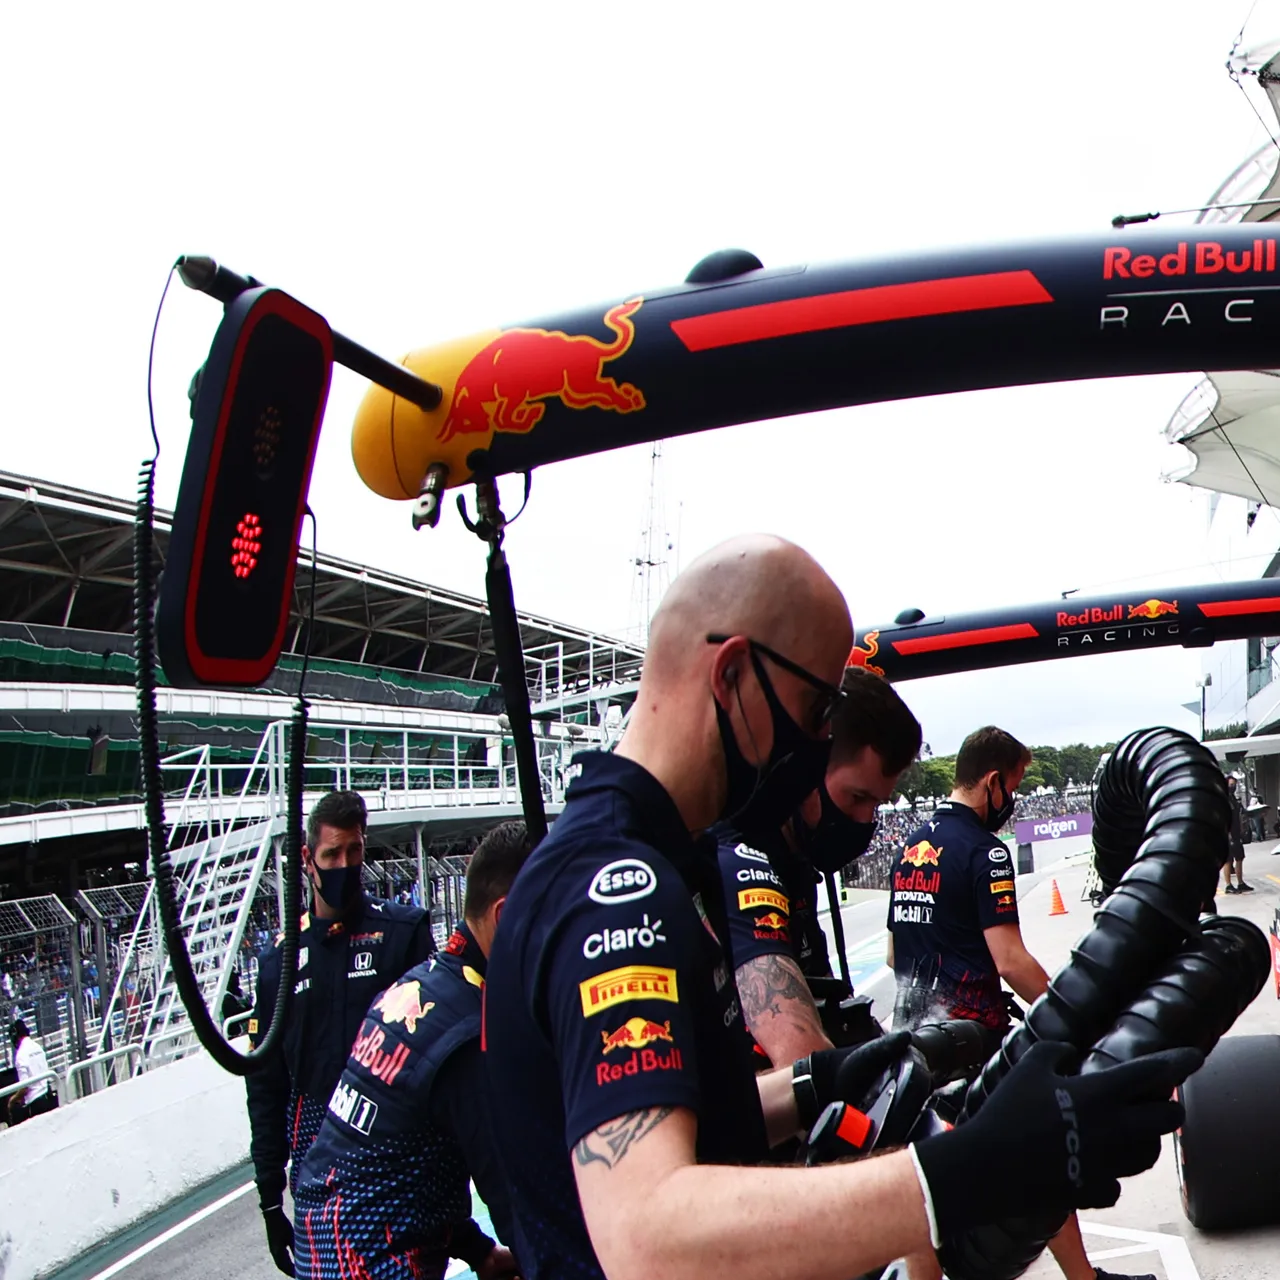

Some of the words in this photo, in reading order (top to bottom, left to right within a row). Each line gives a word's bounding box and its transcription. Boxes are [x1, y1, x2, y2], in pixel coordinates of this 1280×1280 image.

[1103, 242, 1187, 279] Red
[1195, 239, 1275, 274] Bull
[1056, 609, 1091, 628] Red
[1091, 604, 1124, 624] Bull
[1057, 624, 1180, 647] RACING
[600, 867, 648, 892] Esso
[737, 868, 782, 886] Claro
[894, 871, 914, 893] Red
[914, 870, 941, 894] Bull
[894, 892, 936, 905] HONDA
[583, 917, 663, 960] Claro
[347, 969, 378, 979] HONDA
[590, 973, 670, 1006] PIRELLI
[371, 1028, 412, 1086] Bull
[596, 1052, 638, 1087] Red
[640, 1046, 682, 1075] Bull
